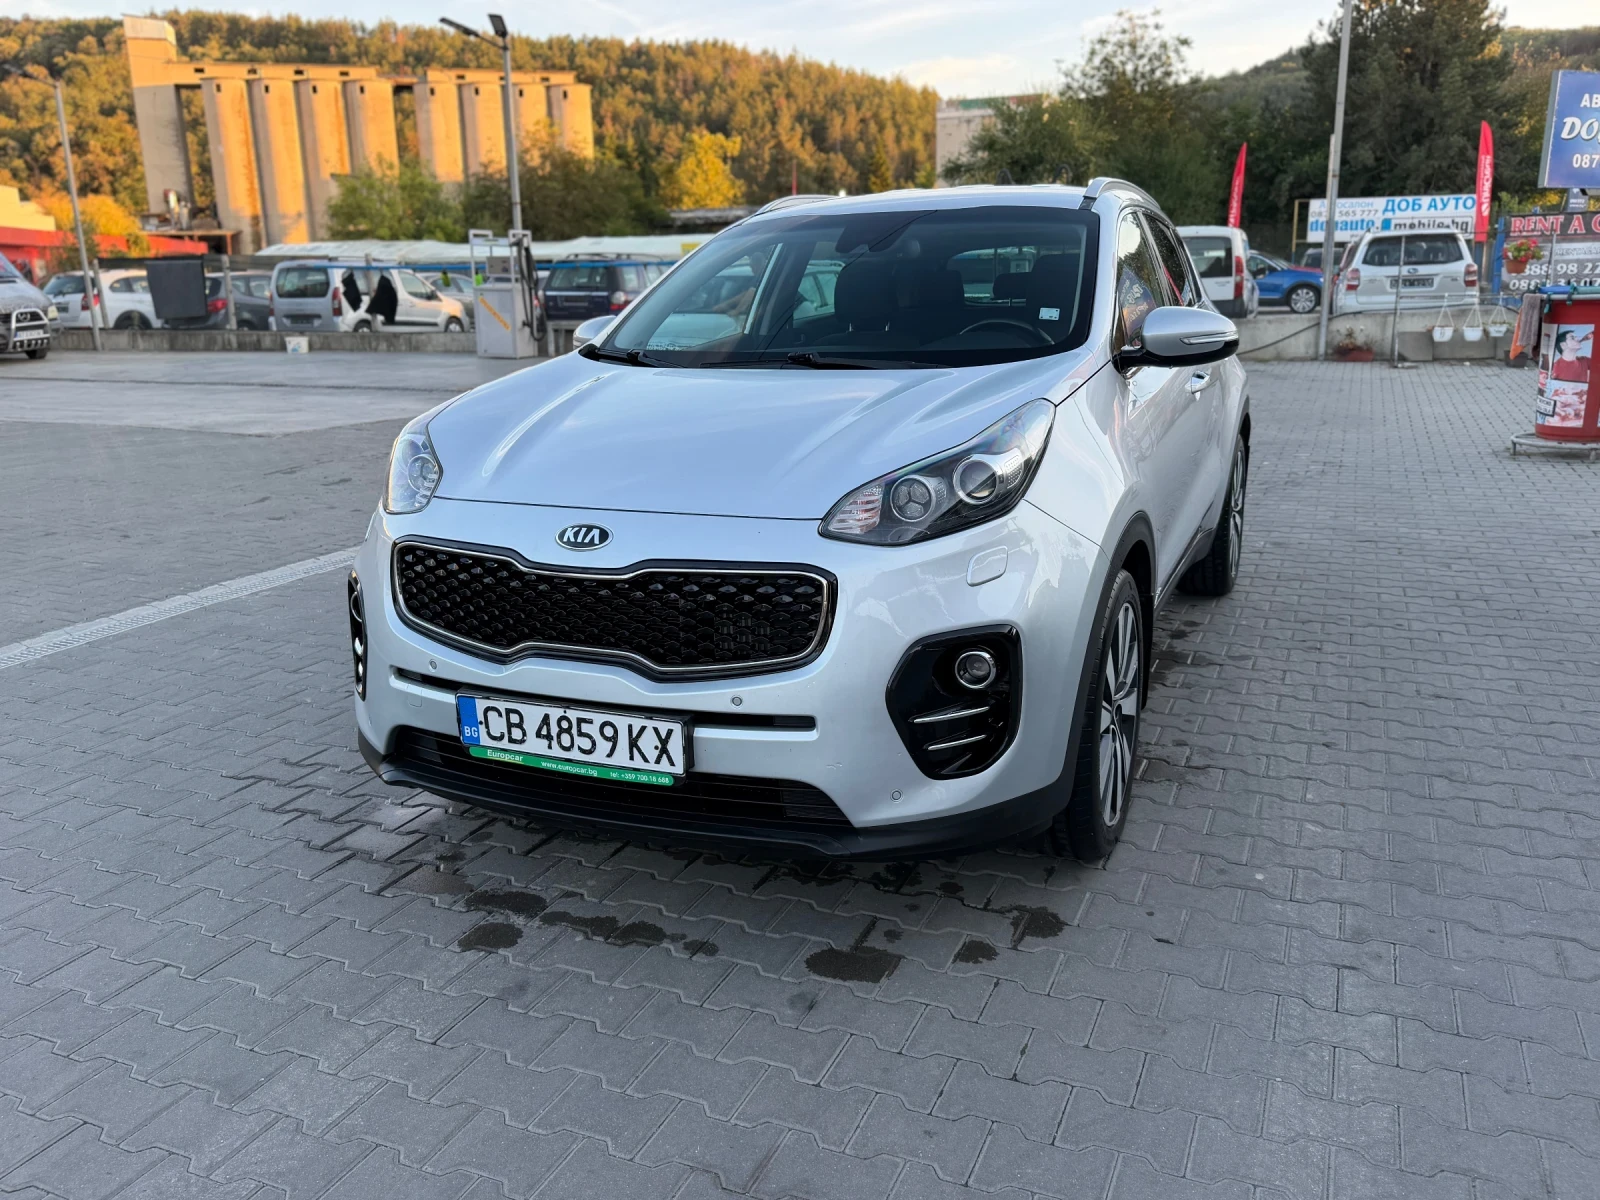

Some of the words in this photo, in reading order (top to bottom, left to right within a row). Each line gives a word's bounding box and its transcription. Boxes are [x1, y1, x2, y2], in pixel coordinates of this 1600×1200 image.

[1319, 200, 1374, 208] Аосалон
[1382, 198, 1422, 215] ДОБ
[1427, 196, 1476, 211] АУТО
[1338, 210, 1357, 218] 565
[1510, 215, 1564, 236] RENT
[1568, 214, 1586, 234] A
[1556, 263, 1578, 275] 98
[562, 527, 600, 544] KIA
[464, 726, 478, 738] BG
[535, 713, 619, 758] 4859
[627, 723, 676, 767] KX
[487, 749, 523, 762] Europcar
[541, 761, 598, 777] www.europcar.bg
